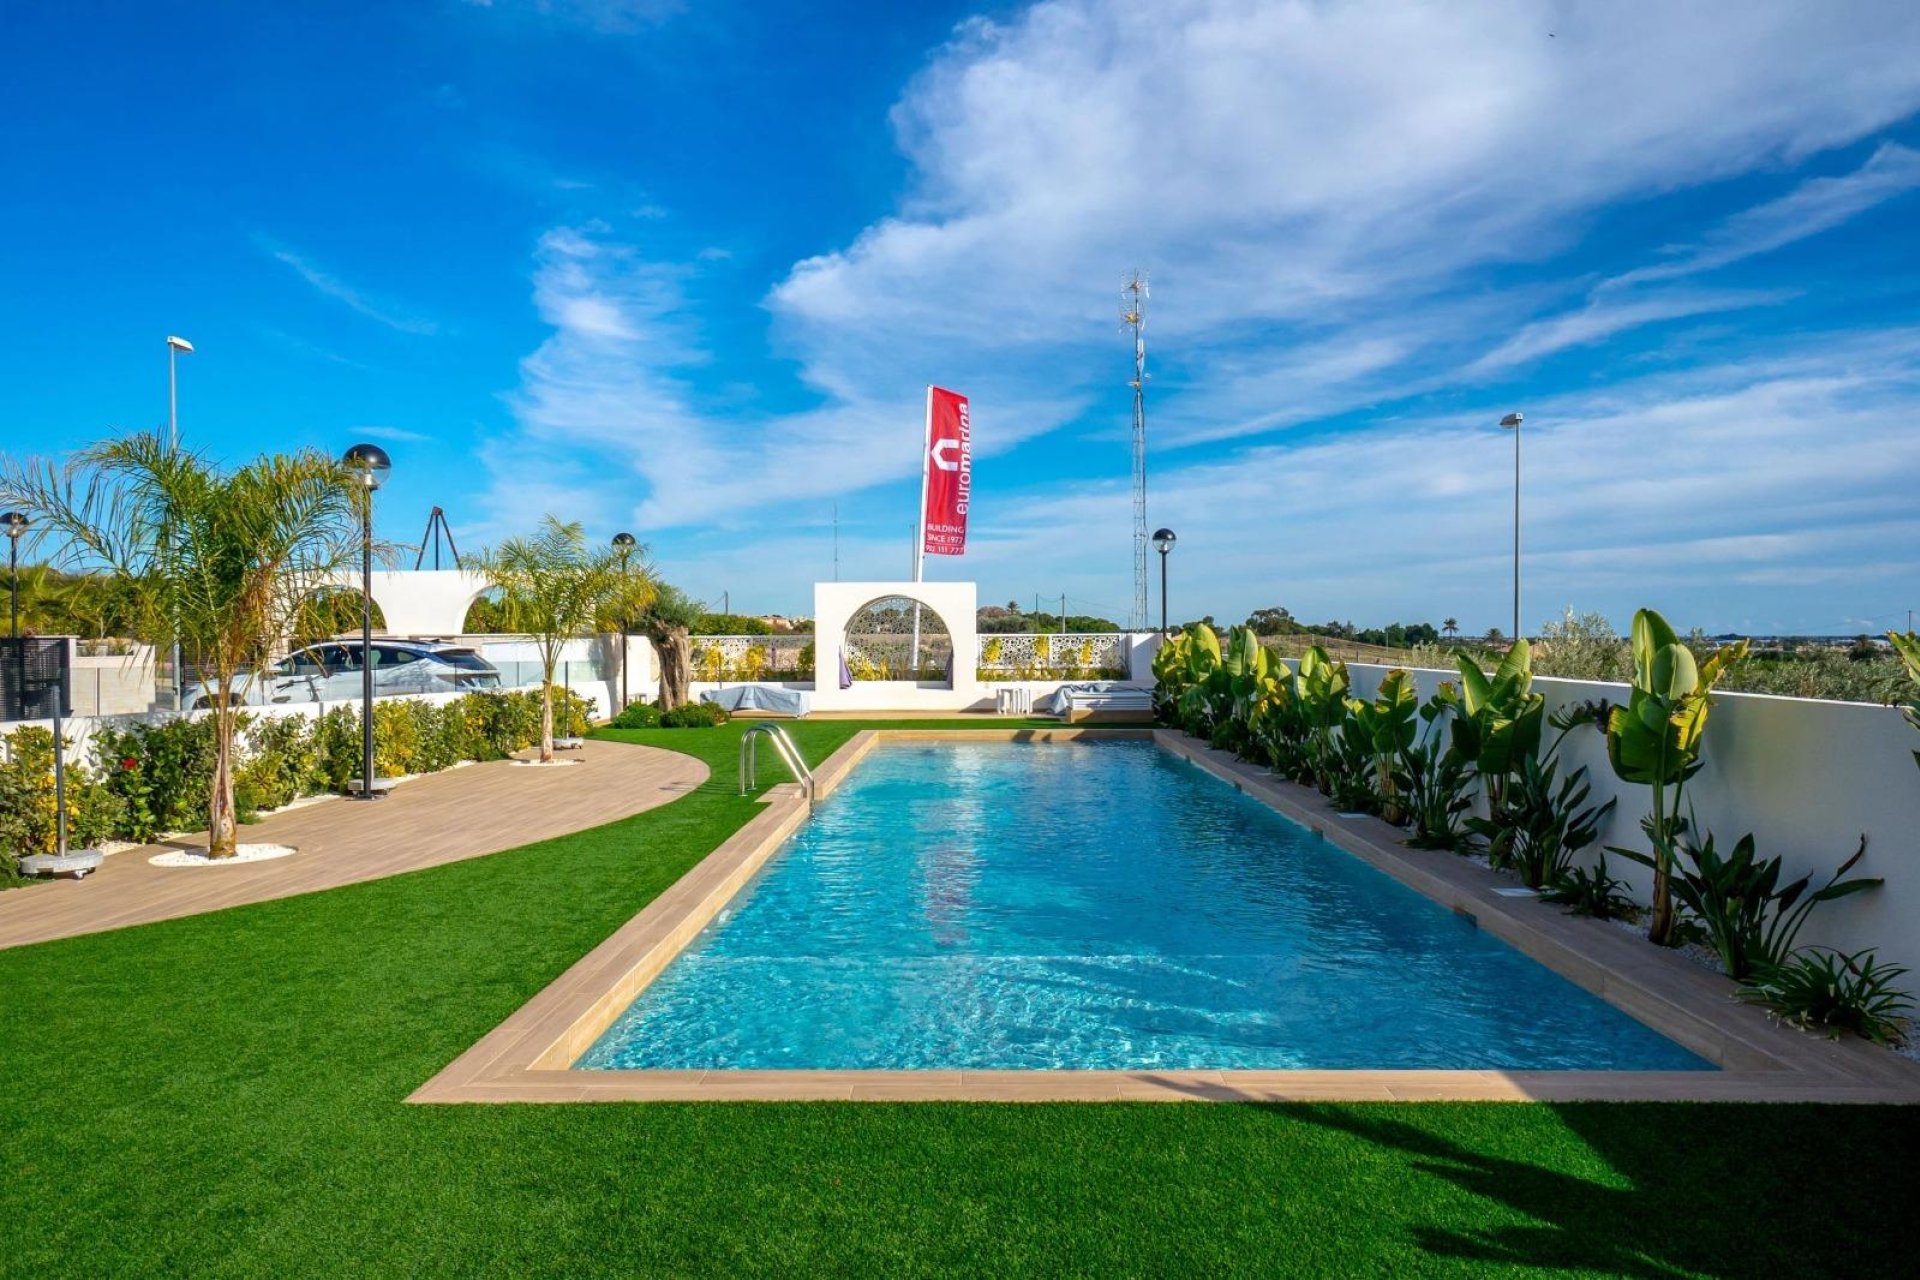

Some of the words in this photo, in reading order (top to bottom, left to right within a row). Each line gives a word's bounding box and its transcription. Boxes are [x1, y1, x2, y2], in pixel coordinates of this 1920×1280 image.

[956, 402, 971, 515] euromarina
[927, 523, 965, 534] BUILDING
[927, 533, 946, 543] SINCE
[947, 536, 964, 545] 1977
